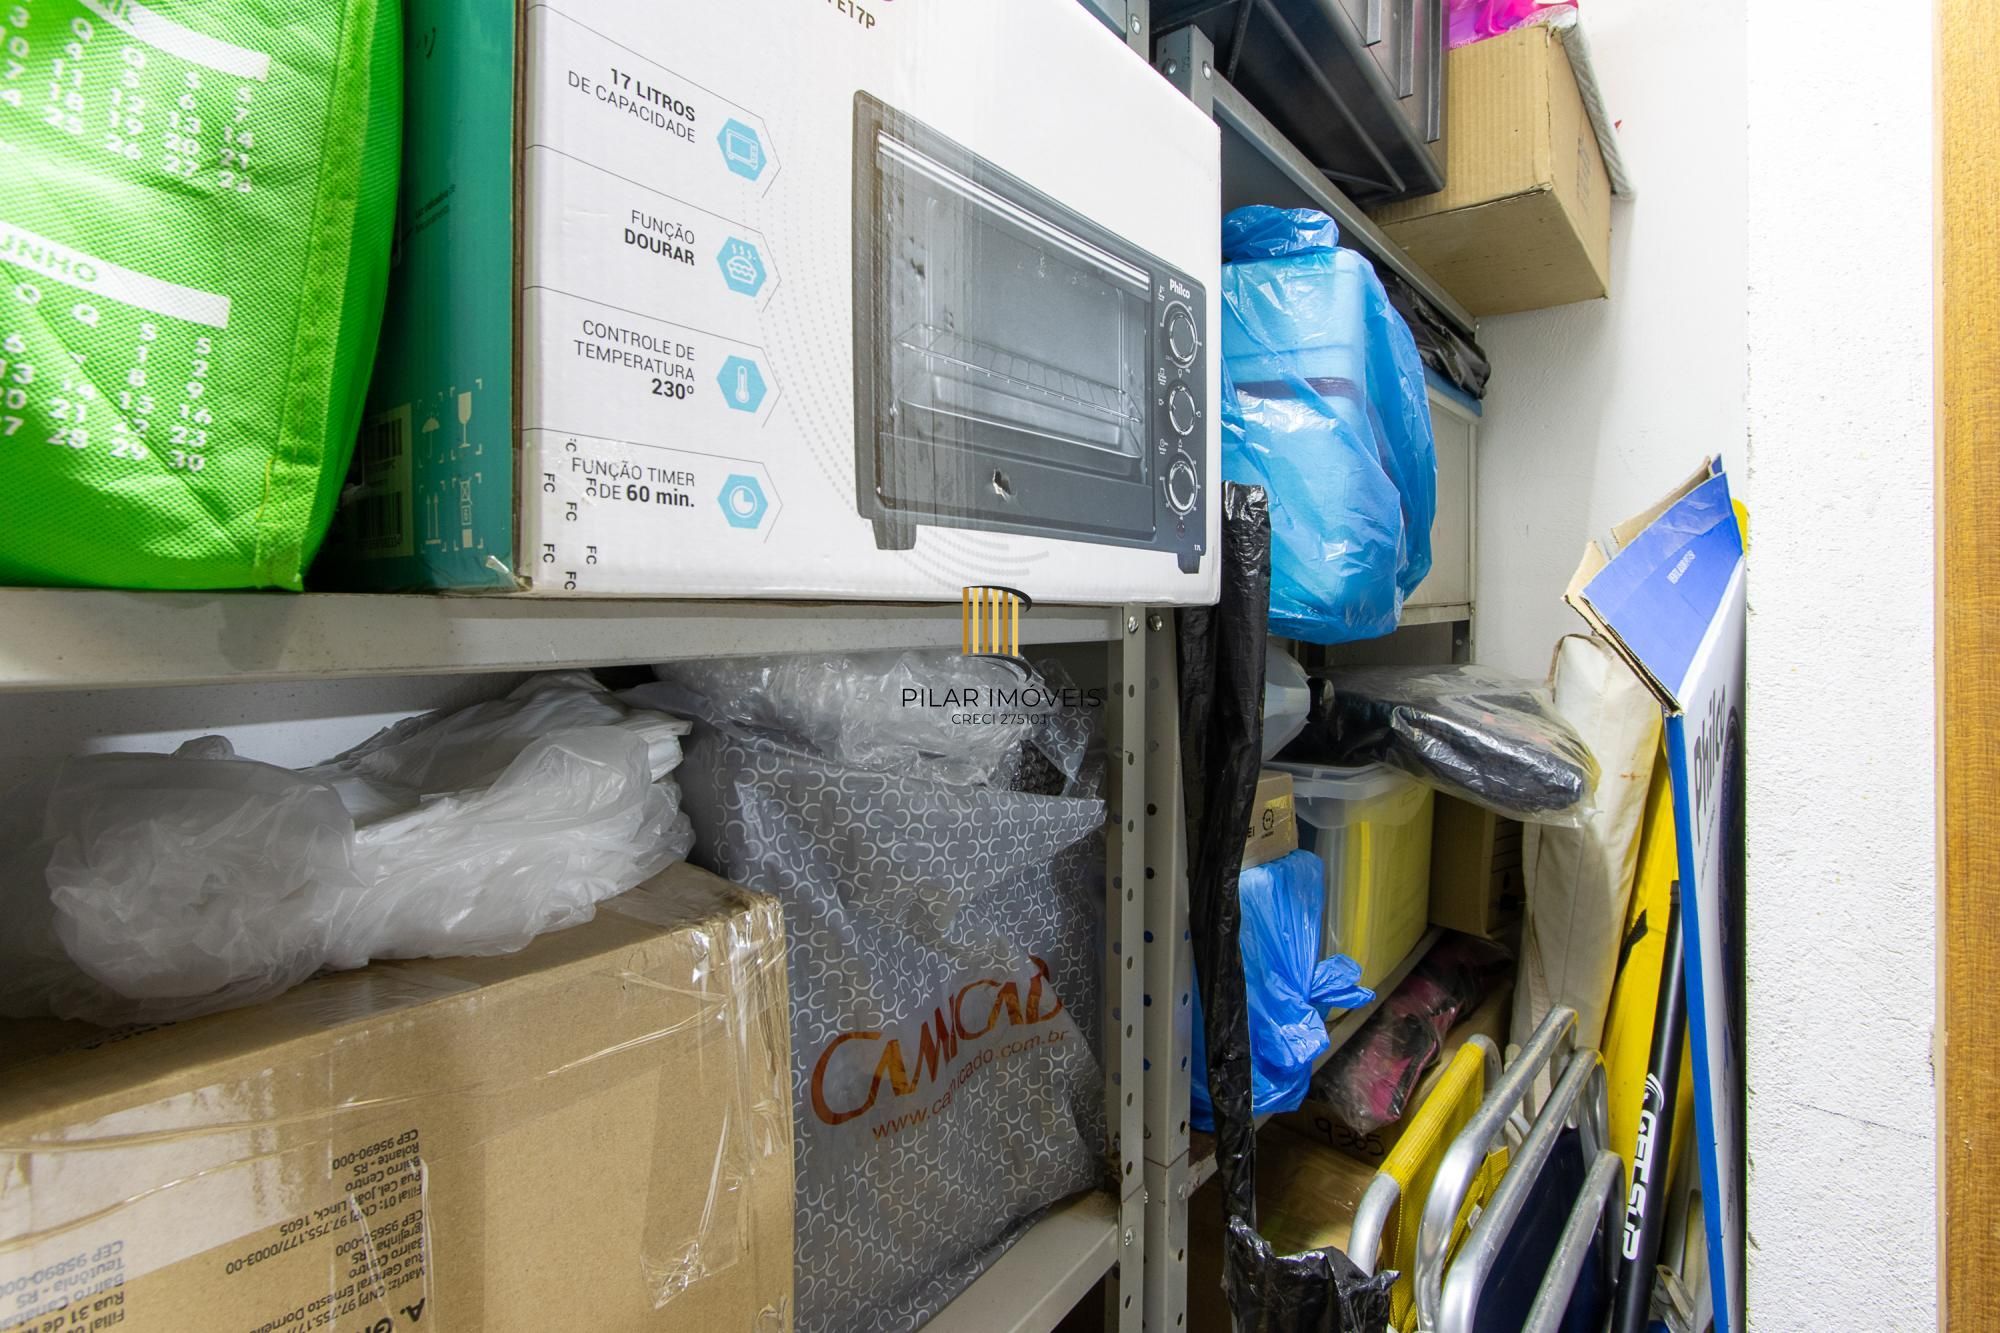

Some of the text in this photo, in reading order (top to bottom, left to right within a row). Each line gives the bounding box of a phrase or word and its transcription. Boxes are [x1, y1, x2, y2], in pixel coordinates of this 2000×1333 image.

[828, 0, 876, 29] E17P
[610, 67, 695, 122] 17 LITROS
[568, 70, 695, 144] DE CAPACIDADE
[631, 209, 695, 245] FUNÇÃO
[624, 227, 695, 266] DOURAR
[1169, 278, 1191, 299] Philco
[582, 319, 695, 361] CONTROLE DE
[573, 339, 695, 382] TEMPERATURA
[544, 473, 556, 494] FC
[572, 457, 695, 487] FUNÇÃO TIMER
[586, 477, 597, 497] FC
[599, 483, 695, 508] DE 60 min.
[566, 501, 578, 522] FC
[543, 543, 555, 564] FC
[586, 545, 597, 566] FC
[564, 571, 577, 591] FC
[1693, 683, 1726, 848] Philco
[331, 1128, 419, 1171] CEP 95690-000
[377, 1142, 420, 1168] Rolante
[353, 1161, 369, 1178] RS
[345, 1170, 385, 1193] Centro
[377, 1180, 399, 1197] Cel.
[398, 1183, 423, 1205] Filial
[313, 1199, 348, 1221] Linck,
[401, 1208, 424, 1228] CEP
[280, 1215, 311, 1237] 1605
[91, 1240, 124, 1264] CEP
[226, 1214, 348, 1276] 97.755.177/0003-00
[53, 1257, 126, 1292] Teutônia
[15, 1290, 39, 1311] RS
[94, 1291, 125, 1313] Rua
[307, 1285, 355, 1313] Ernesto
[71, 1304, 90, 1326] 31
